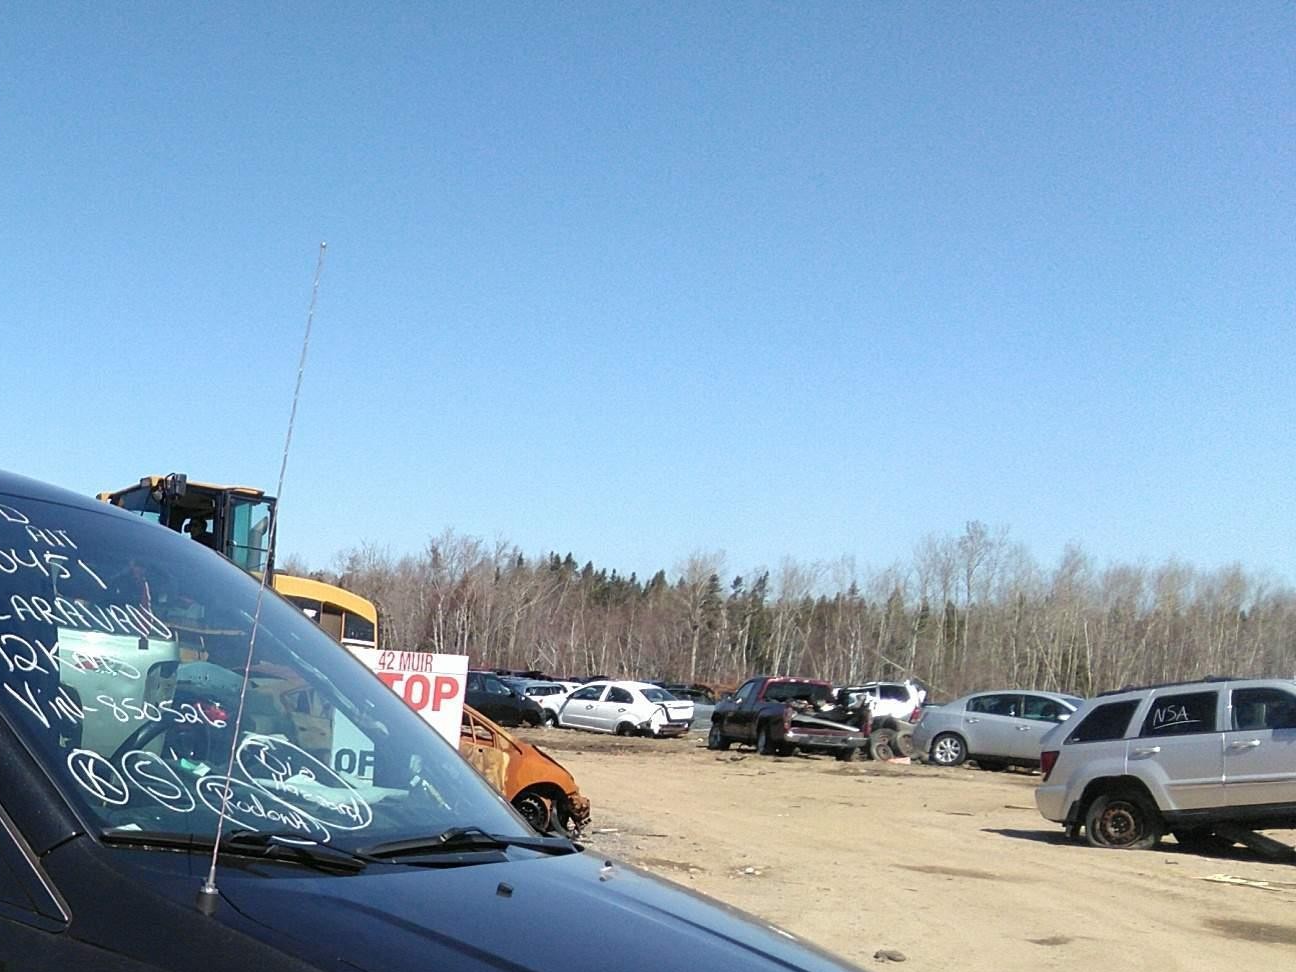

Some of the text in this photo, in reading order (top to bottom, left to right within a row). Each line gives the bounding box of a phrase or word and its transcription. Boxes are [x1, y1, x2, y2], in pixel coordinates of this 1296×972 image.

[378, 651, 434, 672] 42 MUIR
[375, 672, 460, 712] TOP
[1153, 705, 1189, 726] NSA
[79, 759, 182, 799] K S
